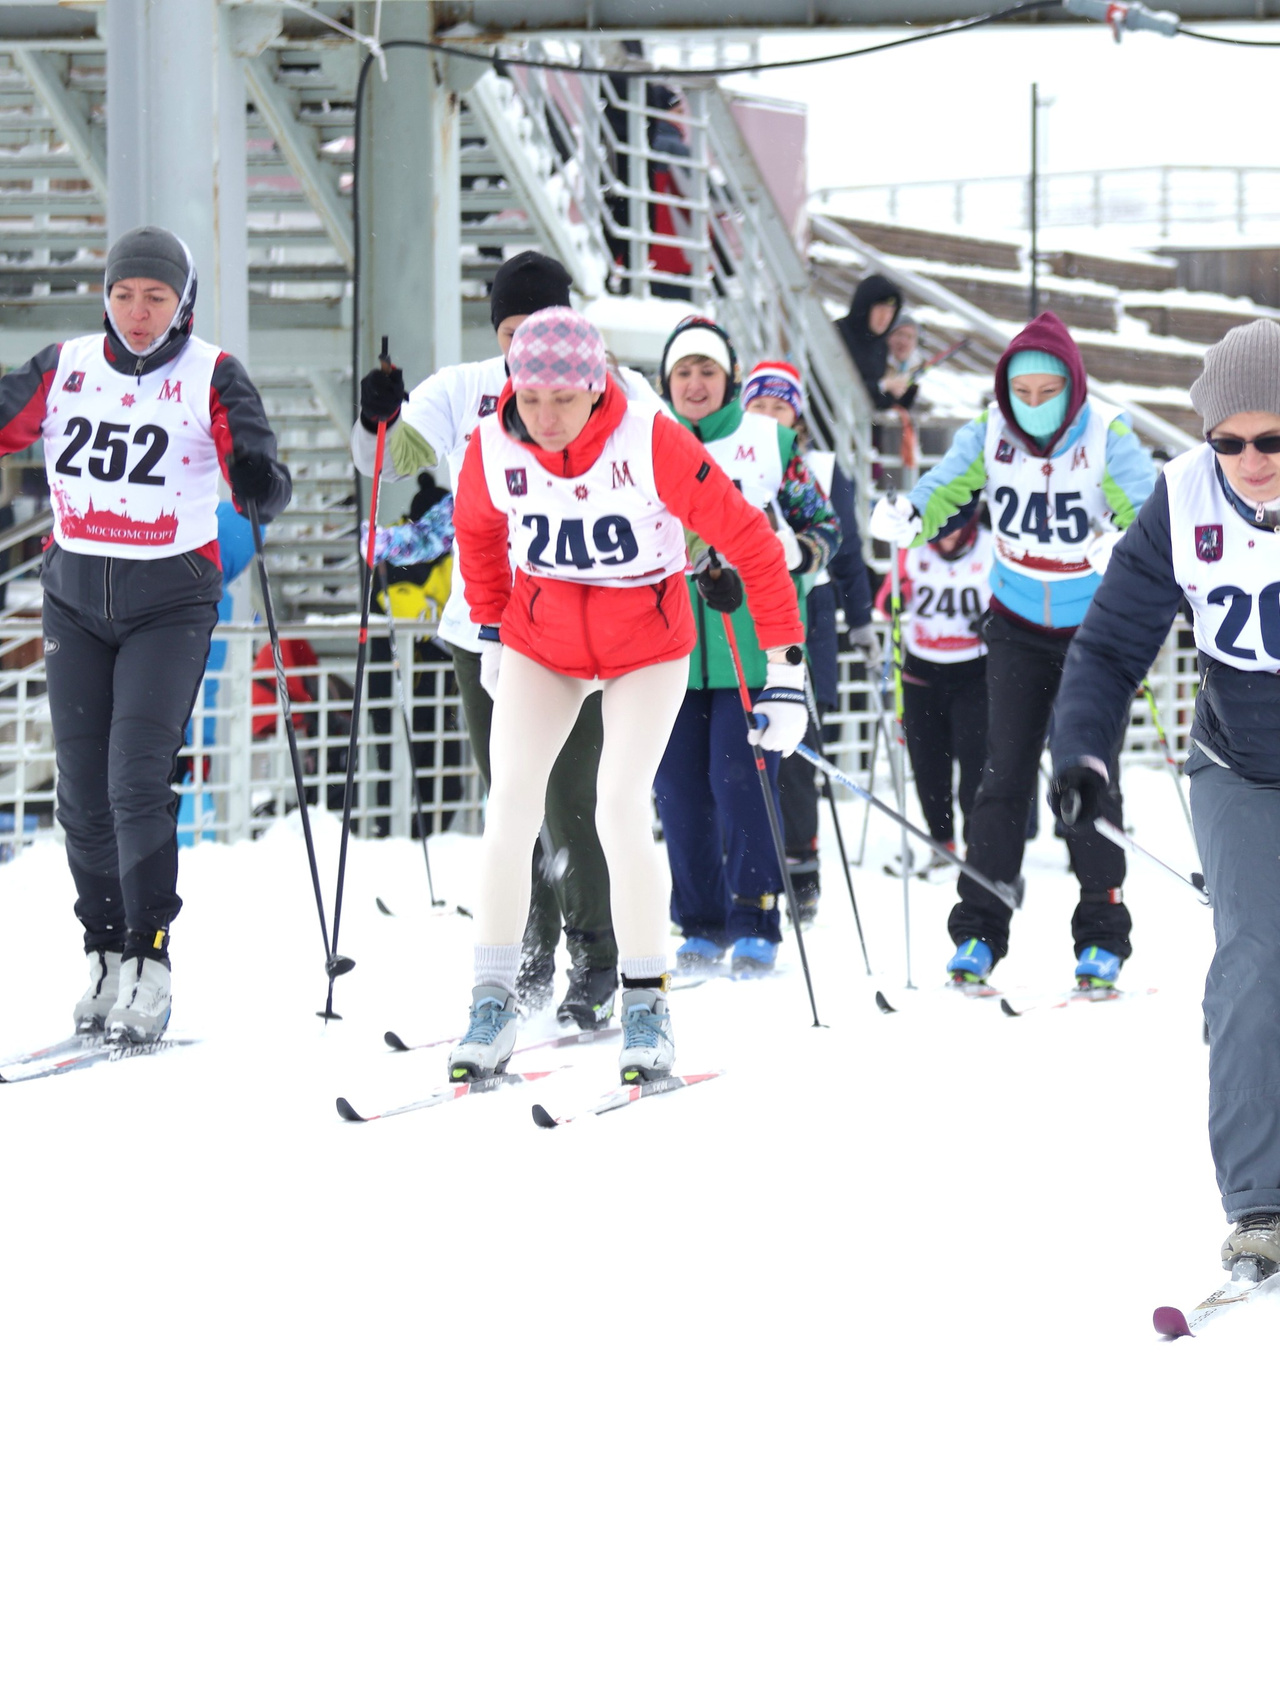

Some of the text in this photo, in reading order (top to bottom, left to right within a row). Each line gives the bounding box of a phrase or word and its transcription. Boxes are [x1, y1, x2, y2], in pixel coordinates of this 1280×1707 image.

[55, 416, 169, 486] 252
[522, 514, 639, 570] 249
[994, 486, 1089, 544] 245
[916, 586, 981, 618] 240
